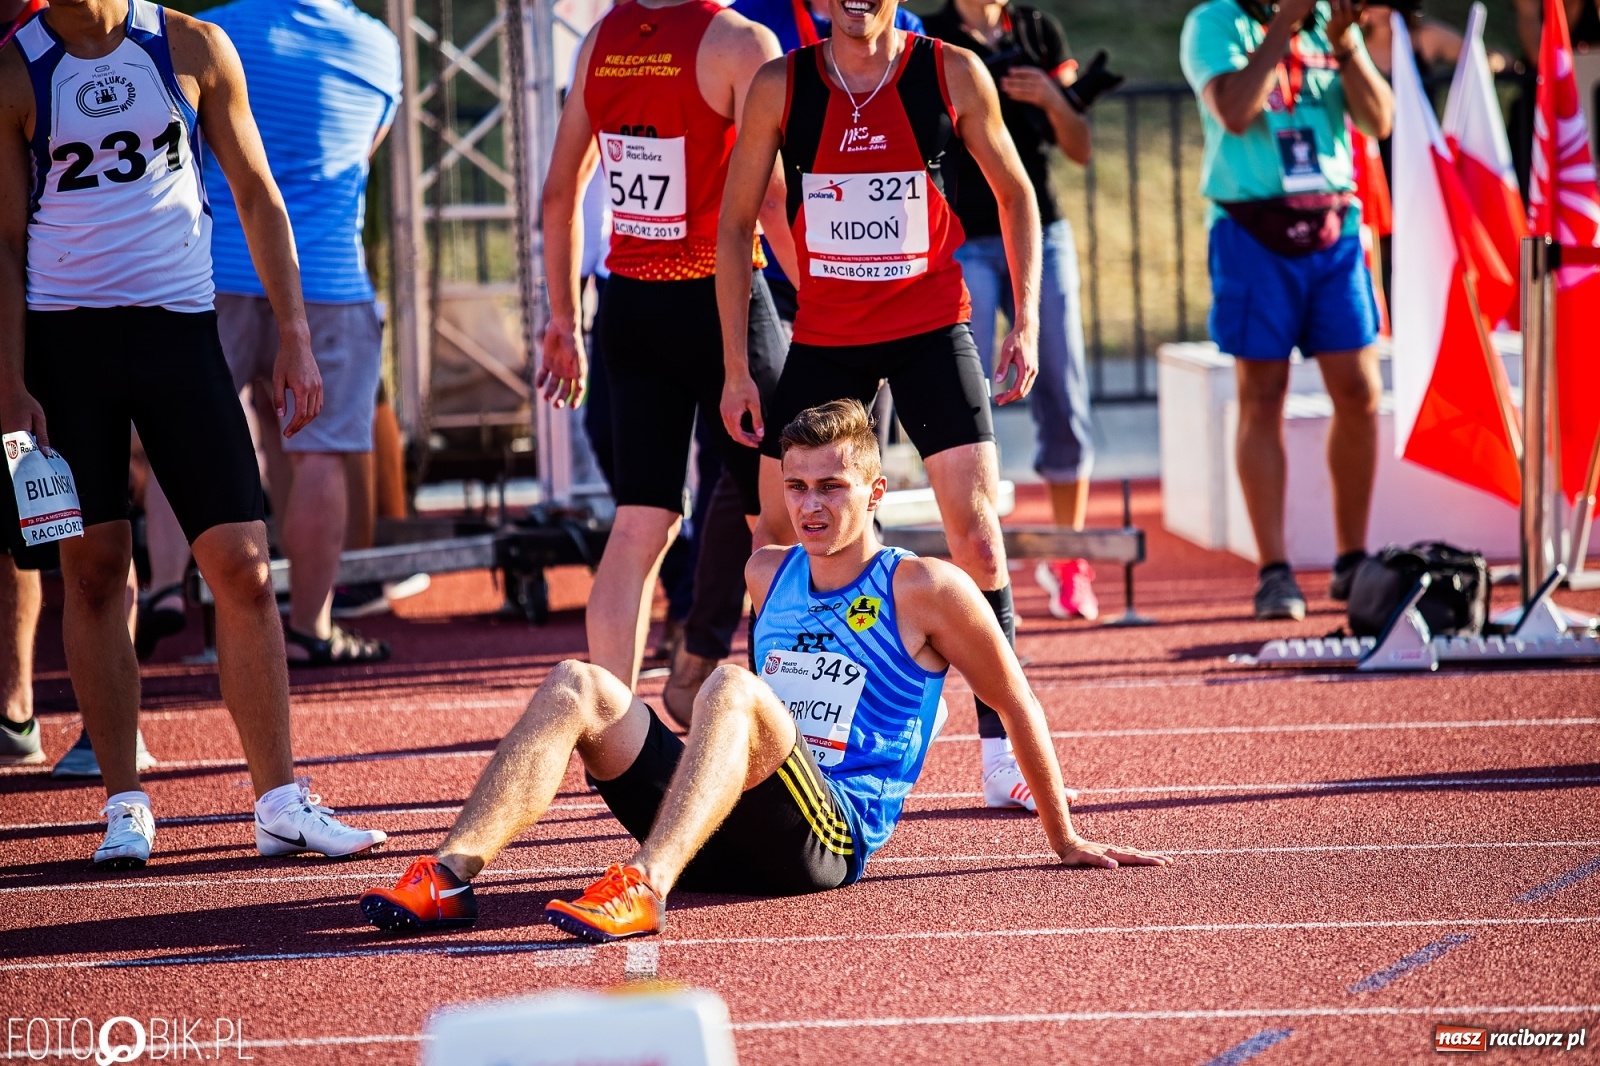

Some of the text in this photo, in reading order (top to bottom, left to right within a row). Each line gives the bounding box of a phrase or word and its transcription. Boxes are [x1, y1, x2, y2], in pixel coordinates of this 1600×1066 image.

[647, 53, 672, 64] KLUB
[595, 65, 681, 77] LEKKOATLETYCZNY
[104, 75, 137, 112] LUKS PODIUM
[52, 120, 183, 193] 231
[626, 151, 662, 162] Racibórz
[610, 170, 670, 211] 547
[808, 176, 921, 202] polanik 321
[654, 227, 680, 238] 2019
[830, 215, 900, 241] KIDOŃ
[822, 263, 912, 278] RACIBÓRZ 2019
[31, 519, 82, 542] RACIBÓRZ
[780, 665, 809, 676] Racibórz
[811, 656, 861, 686] 349
[819, 739, 833, 747] U20
